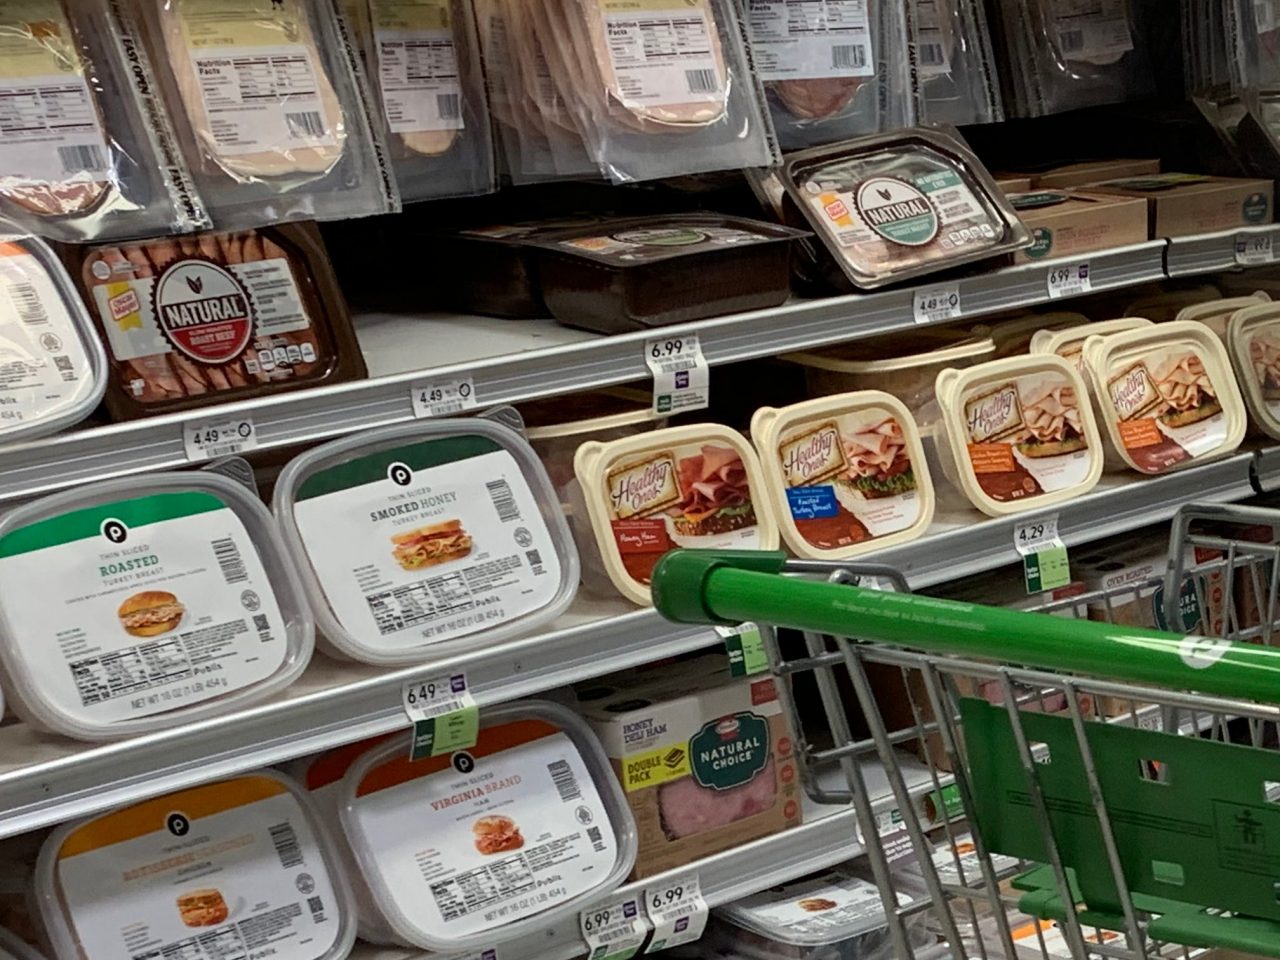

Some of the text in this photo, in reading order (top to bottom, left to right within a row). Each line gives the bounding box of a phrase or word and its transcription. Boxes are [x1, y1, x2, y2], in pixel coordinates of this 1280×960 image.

[122, 37, 150, 95] EASY OPEN
[197, 57, 231, 68] Nutrition
[200, 67, 221, 76] Facts
[169, 168, 184, 195] EASY
[869, 200, 929, 225] NATURAL
[166, 296, 244, 328] NATURAL
[652, 339, 683, 358] 6.99
[420, 389, 443, 404] 4.49
[968, 390, 1016, 432] Healthy
[983, 414, 1008, 434] Ones
[193, 429, 219, 446] 4.49
[783, 430, 836, 478] Healthy
[802, 453, 828, 478] Ones
[611, 460, 672, 511] Healthy
[370, 491, 457, 522] SMOKED HONEY
[631, 485, 661, 509] Ones
[1019, 525, 1044, 542] 4.29
[99, 554, 159, 577] ROASTED
[102, 566, 164, 588] TURKEY BREAST
[1107, 575, 1125, 588] OVEN
[193, 663, 223, 677] Publix
[131, 699, 146, 710] NET
[147, 695, 160, 705] WT
[170, 687, 182, 698] OZ
[205, 678, 221, 691] 454
[623, 718, 654, 734] HONEY
[624, 724, 667, 744] DELI HAM
[700, 736, 761, 763] NATURAL
[627, 756, 662, 774] DOUBLE
[712, 751, 753, 771] CHOICE
[628, 771, 651, 785] PACK
[430, 787, 484, 811] VIRGINIA
[485, 774, 522, 793] BRAND
[537, 875, 562, 888] Publix
[484, 911, 497, 922] NET
[498, 908, 509, 919] WT
[519, 900, 530, 910] OZ
[549, 890, 561, 901] 454
[652, 886, 683, 909] 6.99
[249, 948, 276, 960] Publix
